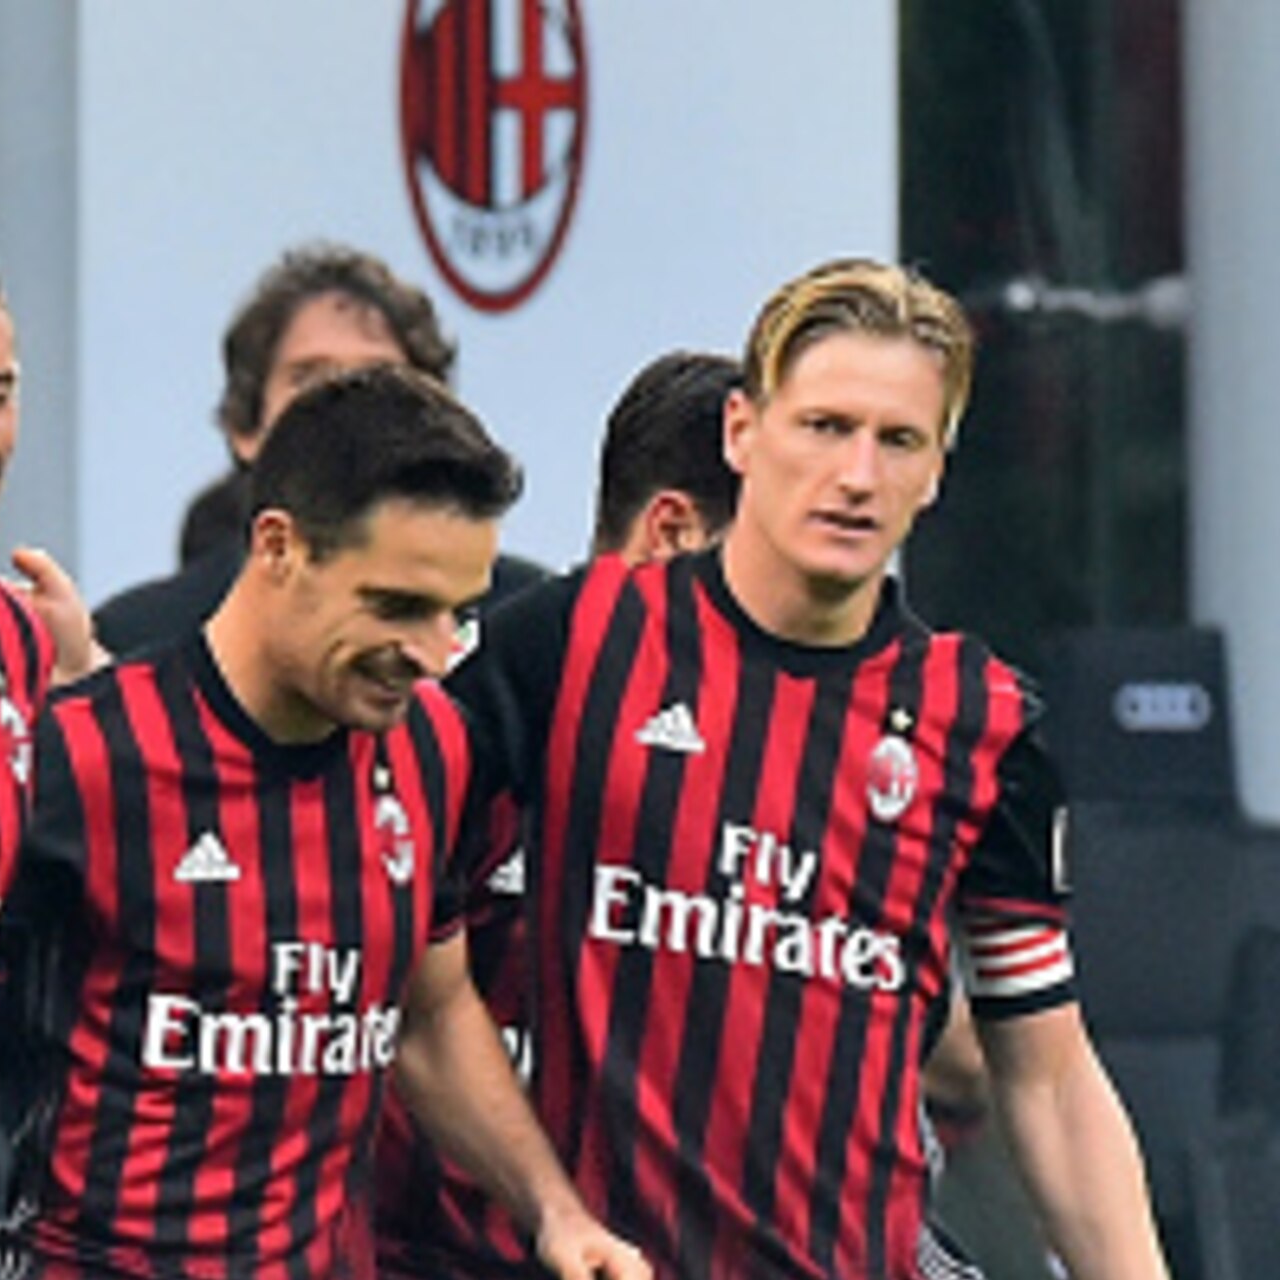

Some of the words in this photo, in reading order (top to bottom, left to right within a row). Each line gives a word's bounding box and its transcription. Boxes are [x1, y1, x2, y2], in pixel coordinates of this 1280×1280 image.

[720, 820, 817, 902] Fly
[588, 863, 908, 993] Emirates
[271, 940, 360, 1004] Fly
[141, 993, 400, 1077] Emirate
